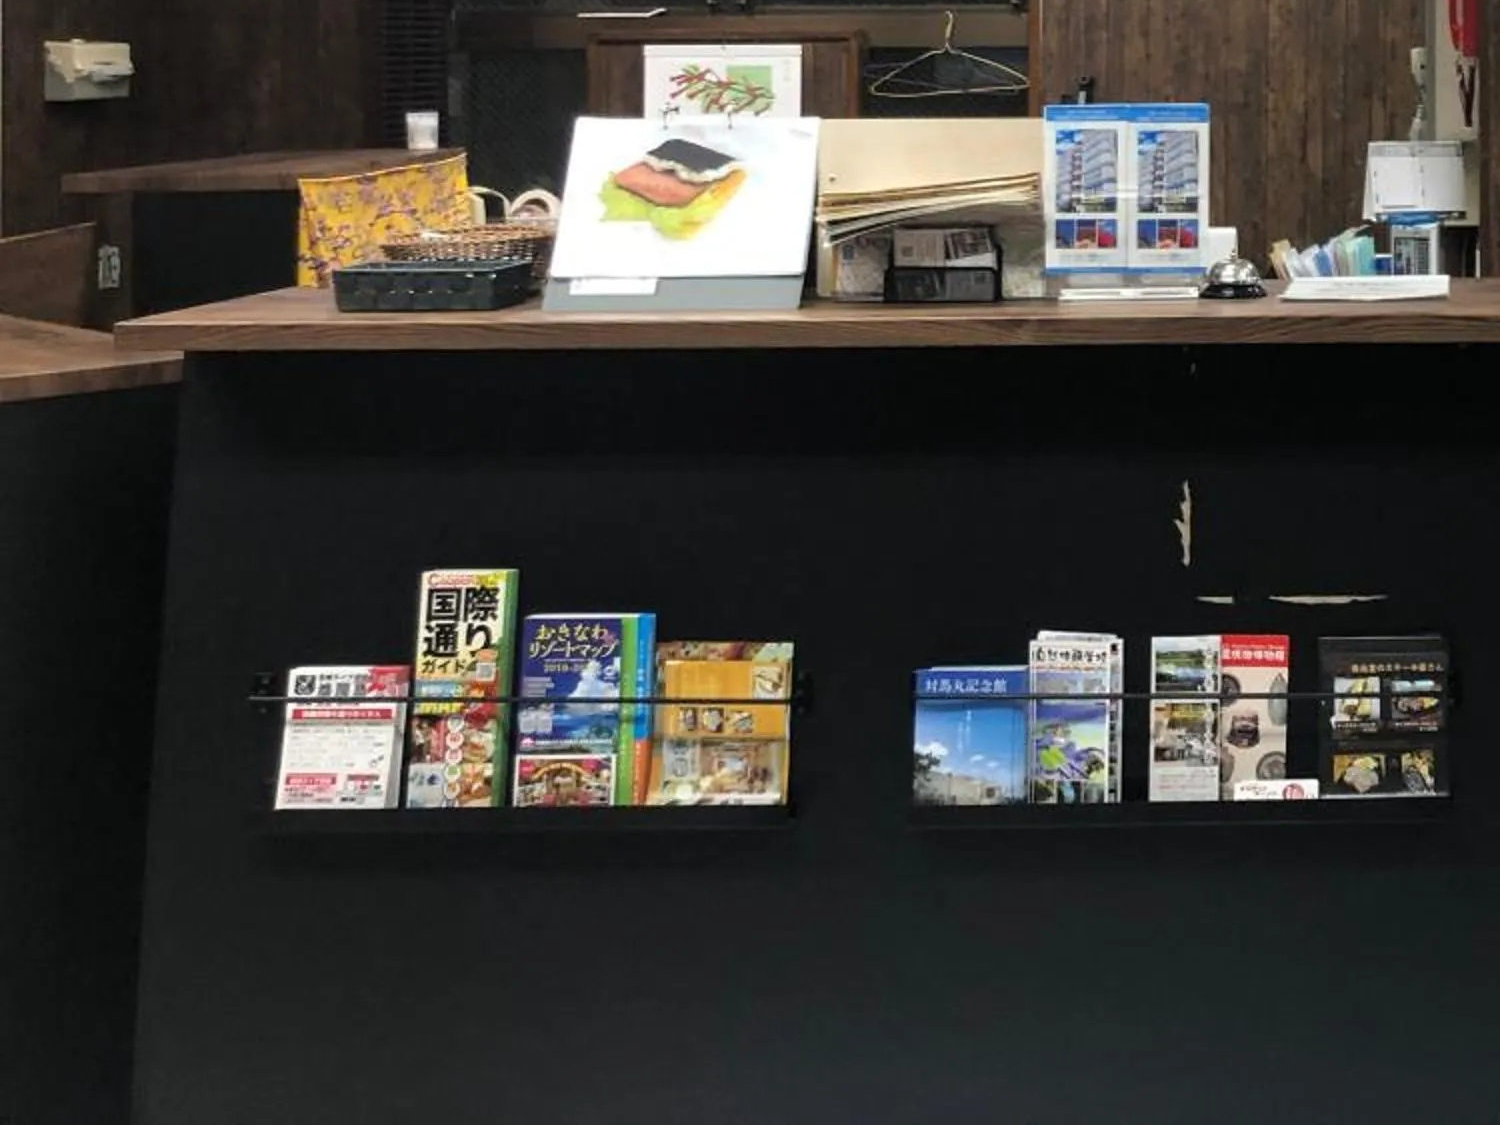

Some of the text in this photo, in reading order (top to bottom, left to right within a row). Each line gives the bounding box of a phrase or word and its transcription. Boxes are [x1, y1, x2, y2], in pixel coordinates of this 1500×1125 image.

[425, 586, 500, 623] 国際
[422, 622, 493, 658] 通り
[535, 622, 610, 642] おきなわ
[528, 639, 619, 659] リゾートマップ
